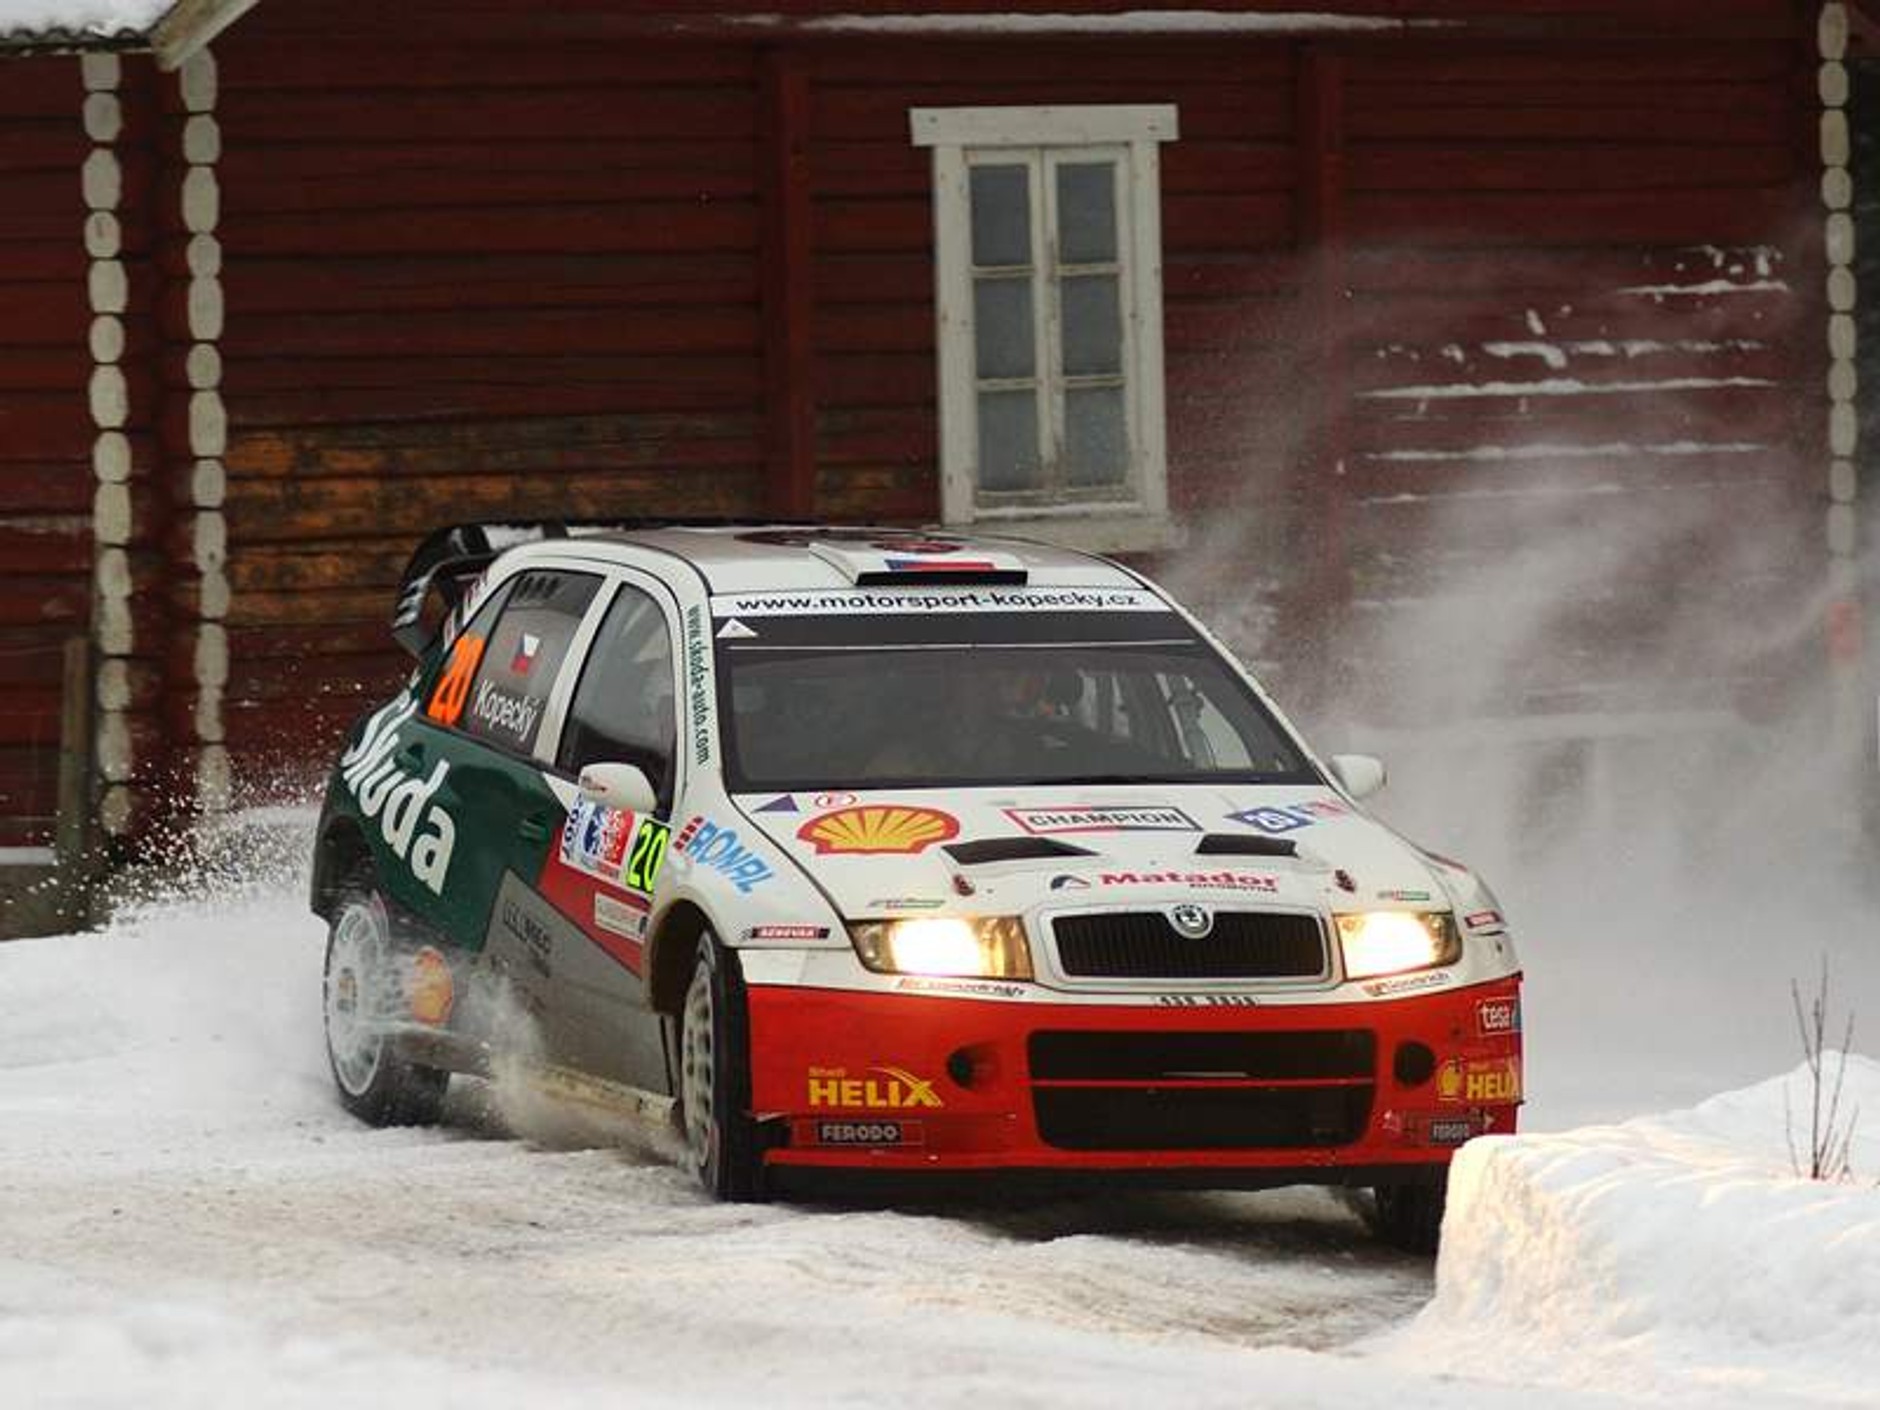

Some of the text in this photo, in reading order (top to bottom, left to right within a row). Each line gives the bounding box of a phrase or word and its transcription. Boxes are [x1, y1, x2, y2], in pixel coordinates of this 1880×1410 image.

[736, 590, 1141, 611] www.motorsport-kopecky.cz
[1027, 809, 1183, 827] CHAMPION
[628, 822, 670, 893] 20
[1100, 871, 1278, 888] Matador
[808, 1072, 943, 1108] HELIX
[821, 1123, 899, 1141] FERODO
